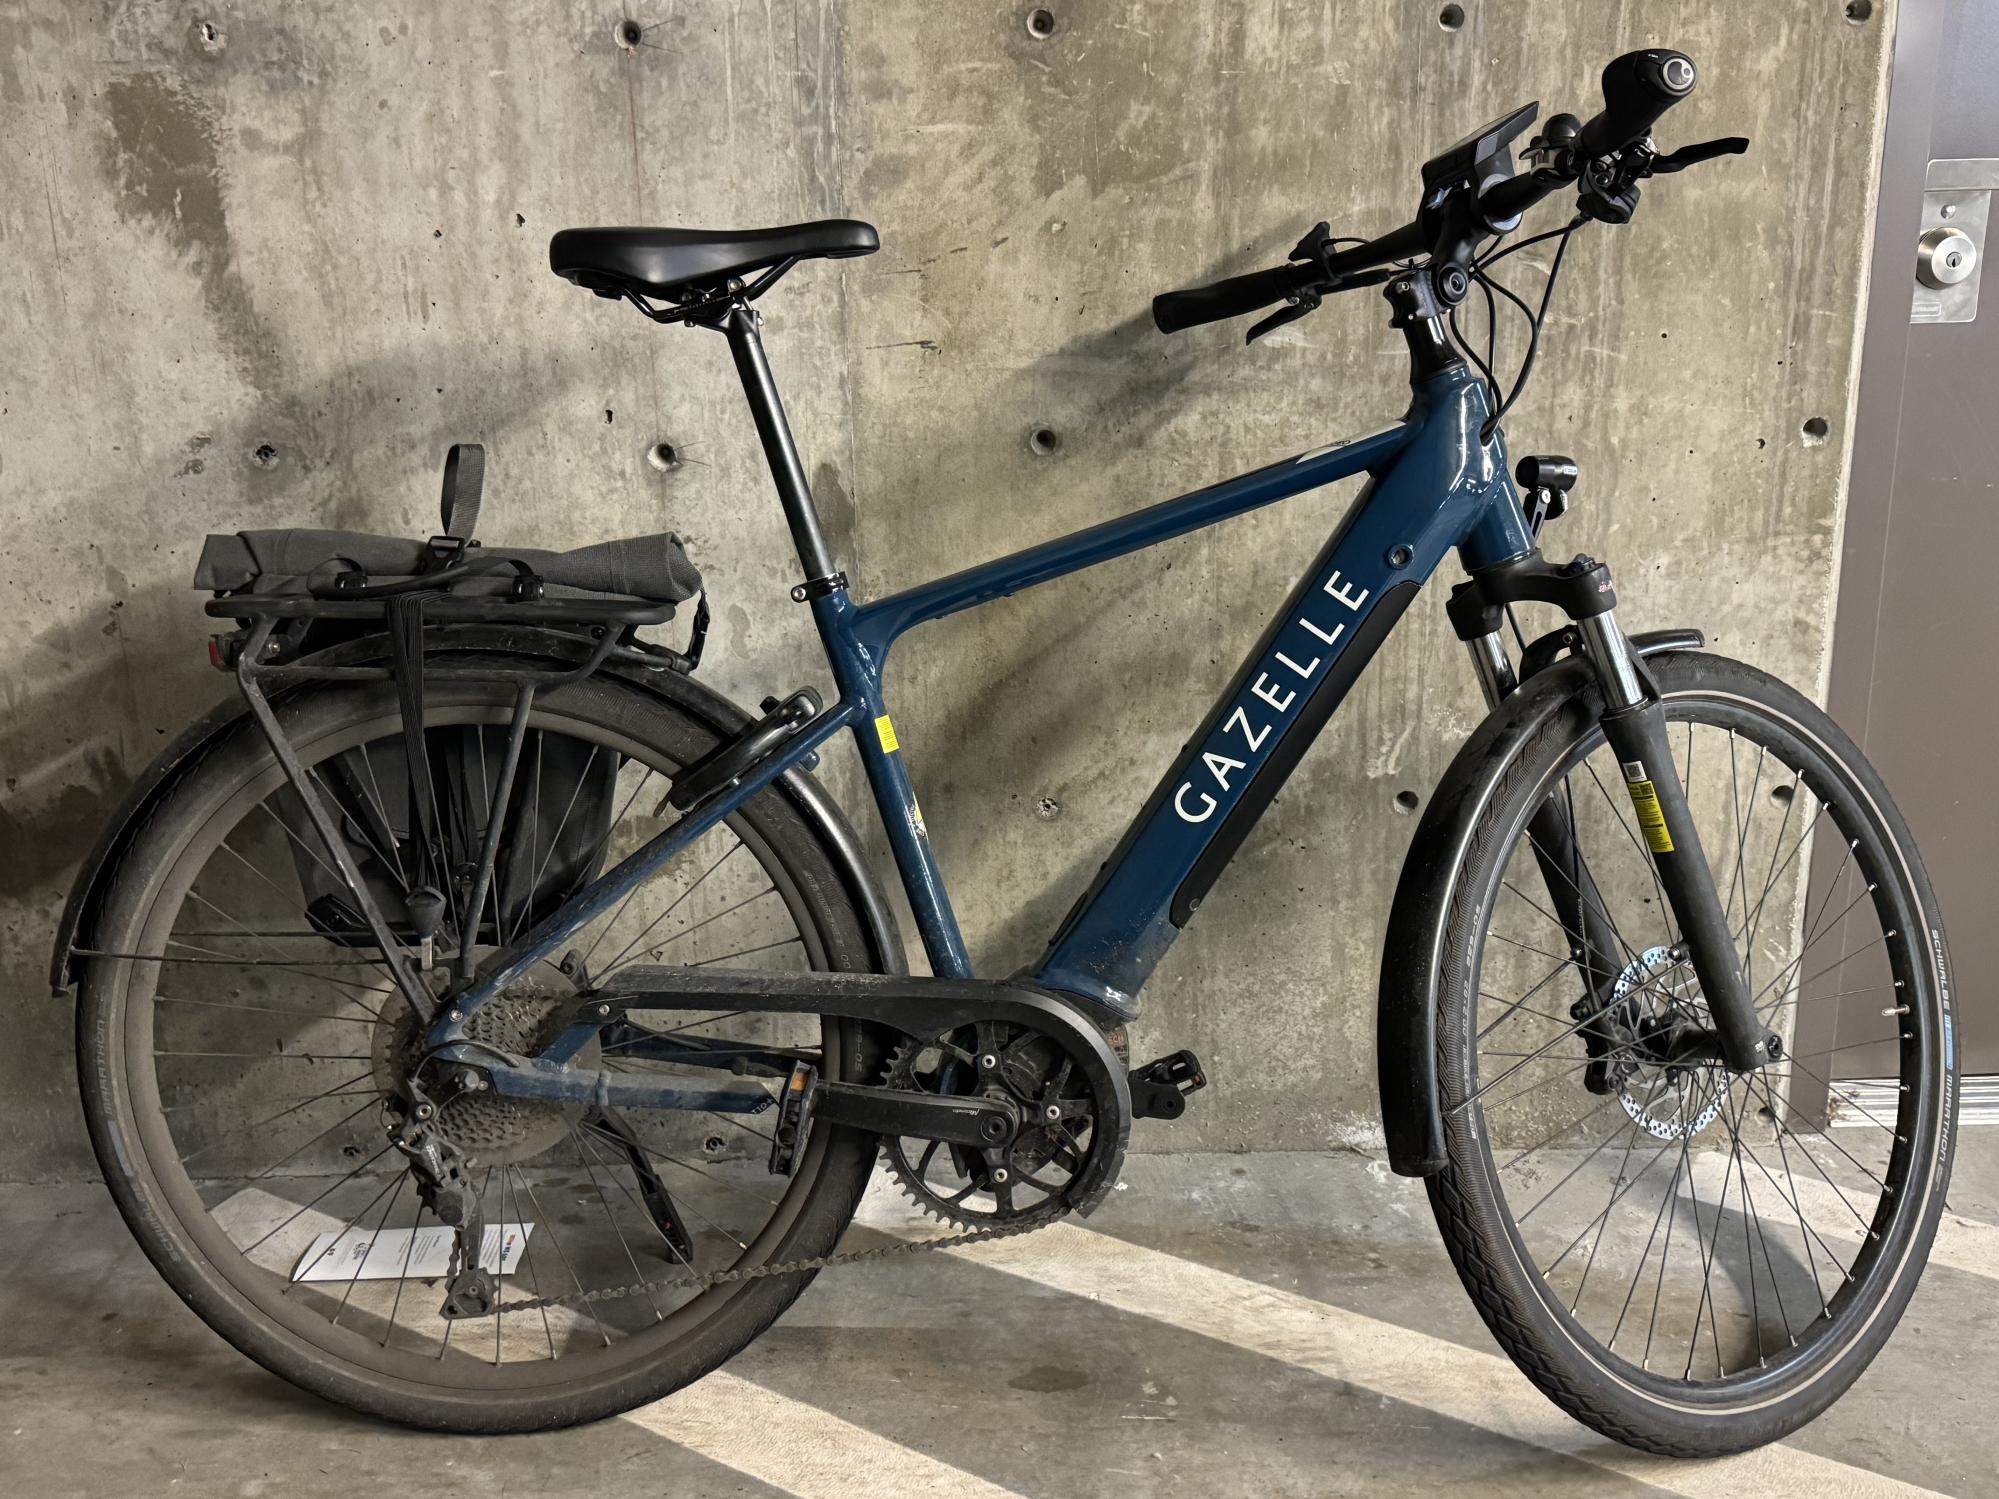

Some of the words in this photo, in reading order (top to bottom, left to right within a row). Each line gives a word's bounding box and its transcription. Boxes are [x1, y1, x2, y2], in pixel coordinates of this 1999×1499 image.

[1174, 570, 1370, 823] GAZELLE
[1931, 928, 1951, 1011] SCHWALBE
[96, 1019, 113, 1115] MARATHON
[1940, 1074, 1953, 1162] MARATHON
